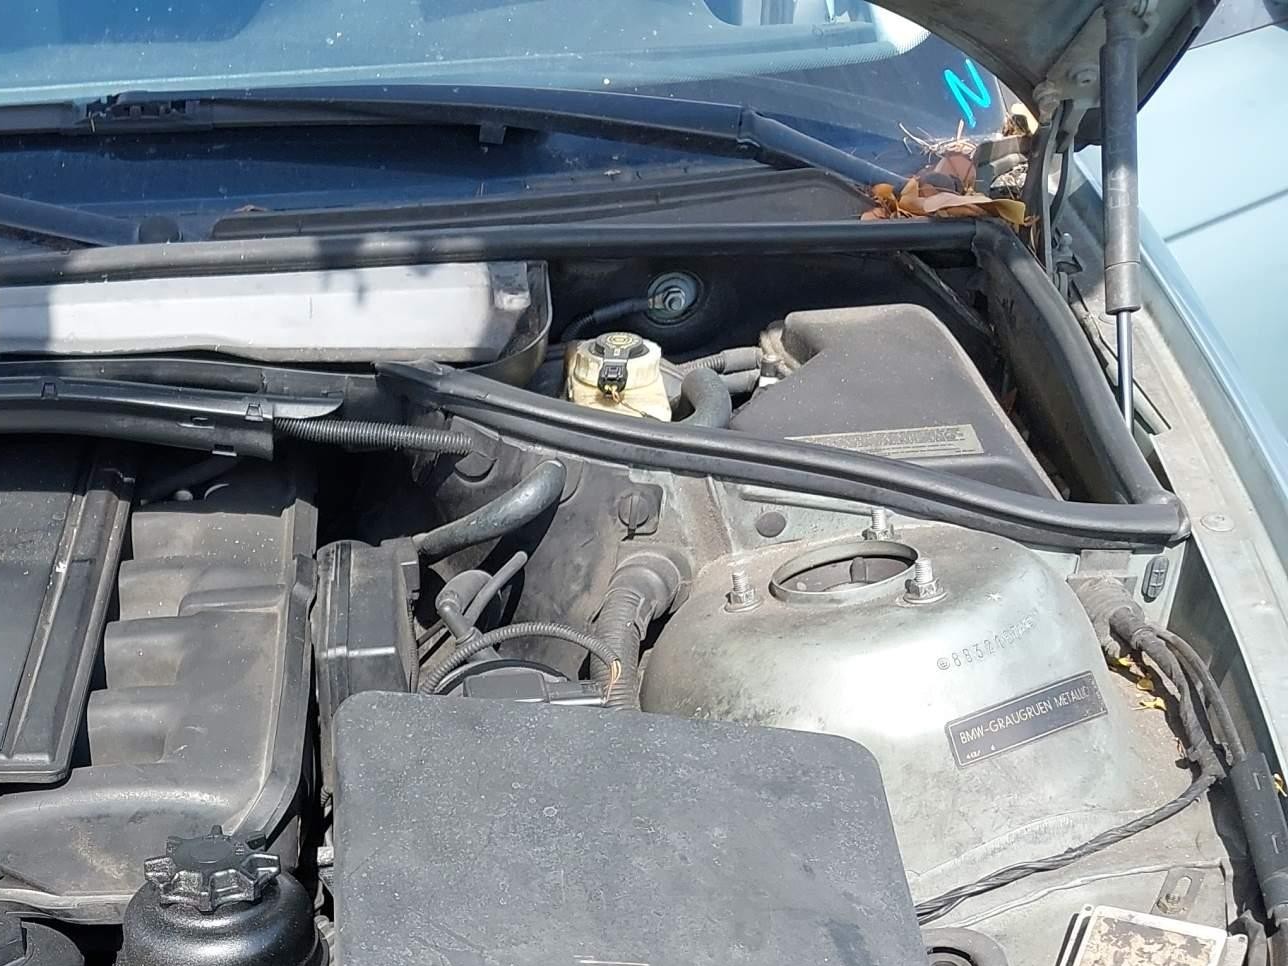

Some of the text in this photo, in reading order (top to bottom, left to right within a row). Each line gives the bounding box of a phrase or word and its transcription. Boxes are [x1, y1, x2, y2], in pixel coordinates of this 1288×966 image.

[942, 58, 991, 128] N
[959, 701, 1053, 744] BMW-GRAUGRUEN
[1054, 686, 1090, 709] METALLIC
